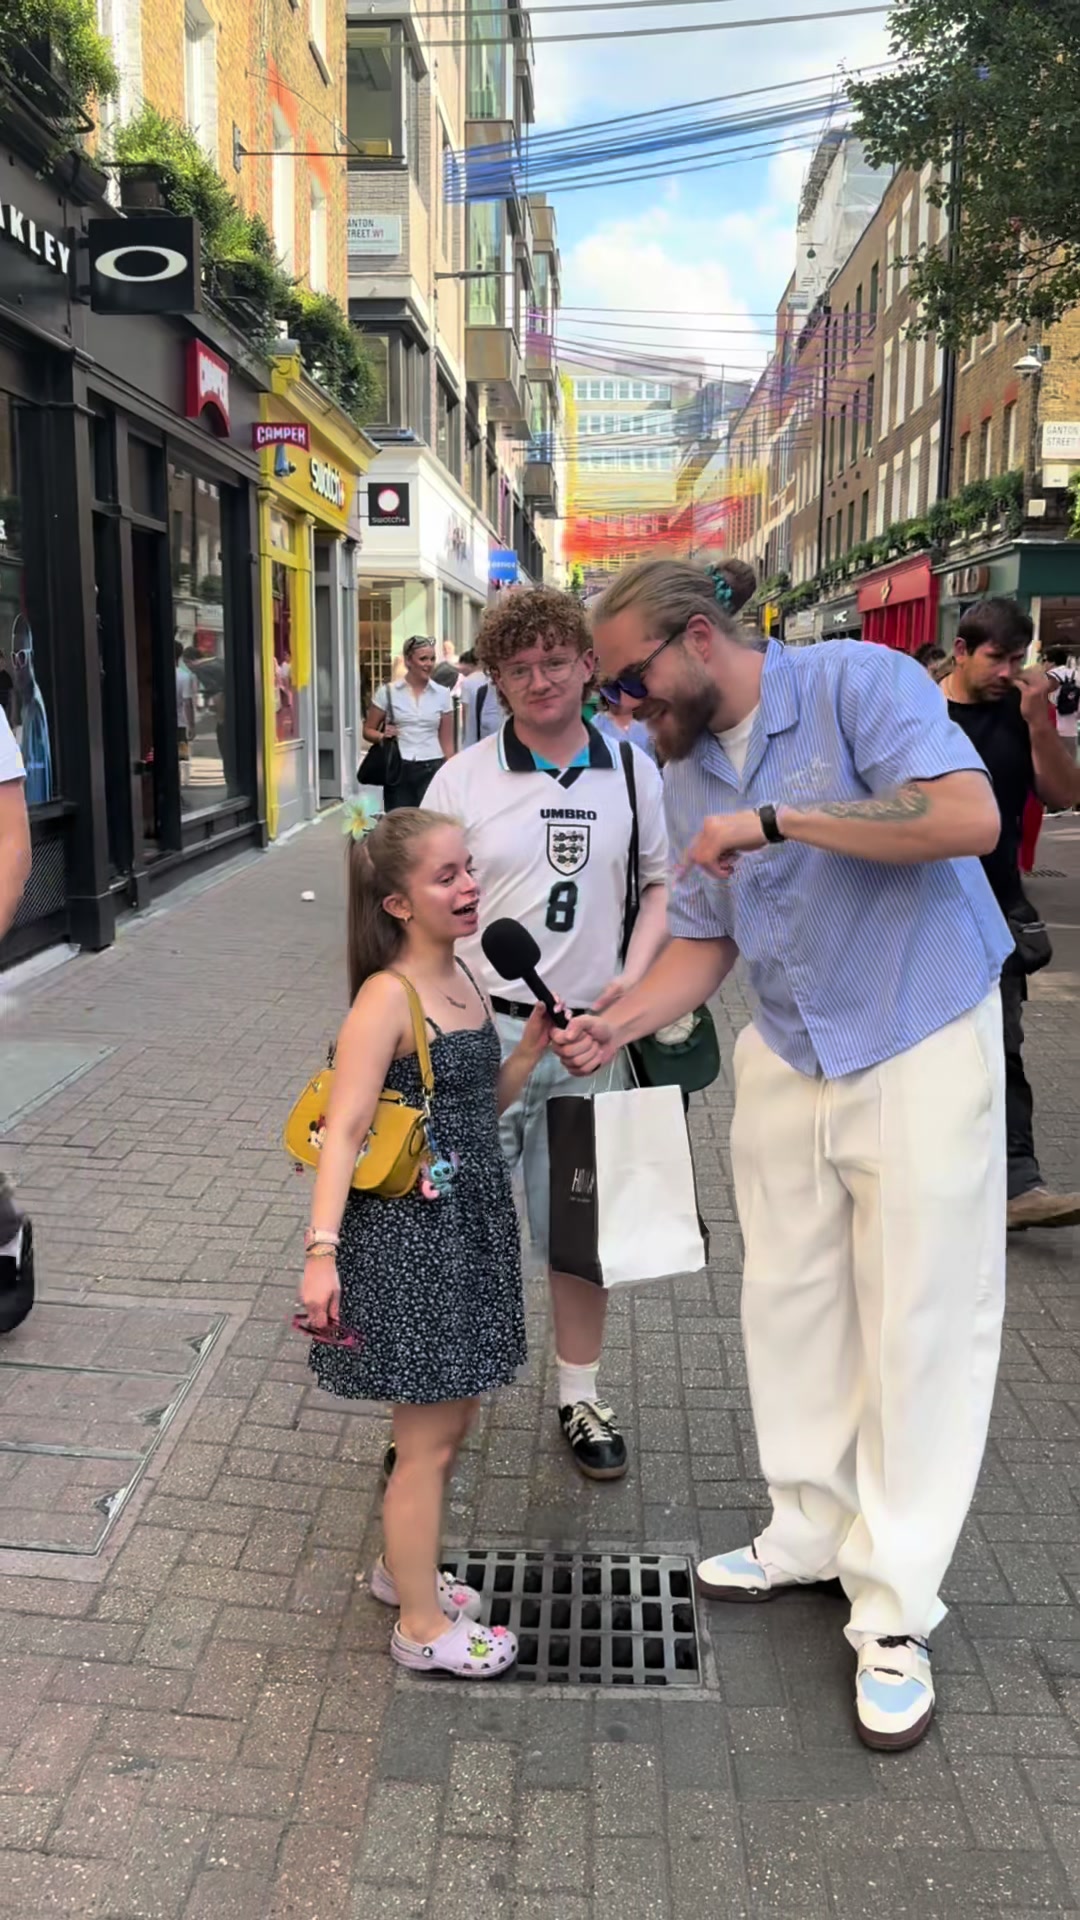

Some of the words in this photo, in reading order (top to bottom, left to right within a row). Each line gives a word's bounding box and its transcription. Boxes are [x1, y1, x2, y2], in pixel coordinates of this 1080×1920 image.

[256, 426, 306, 446] CAMPER
[1046, 425, 1079, 435] GANTON
[1046, 437, 1076, 446] STREET
[540, 808, 598, 820] UMBRO
[545, 880, 579, 933] 8
